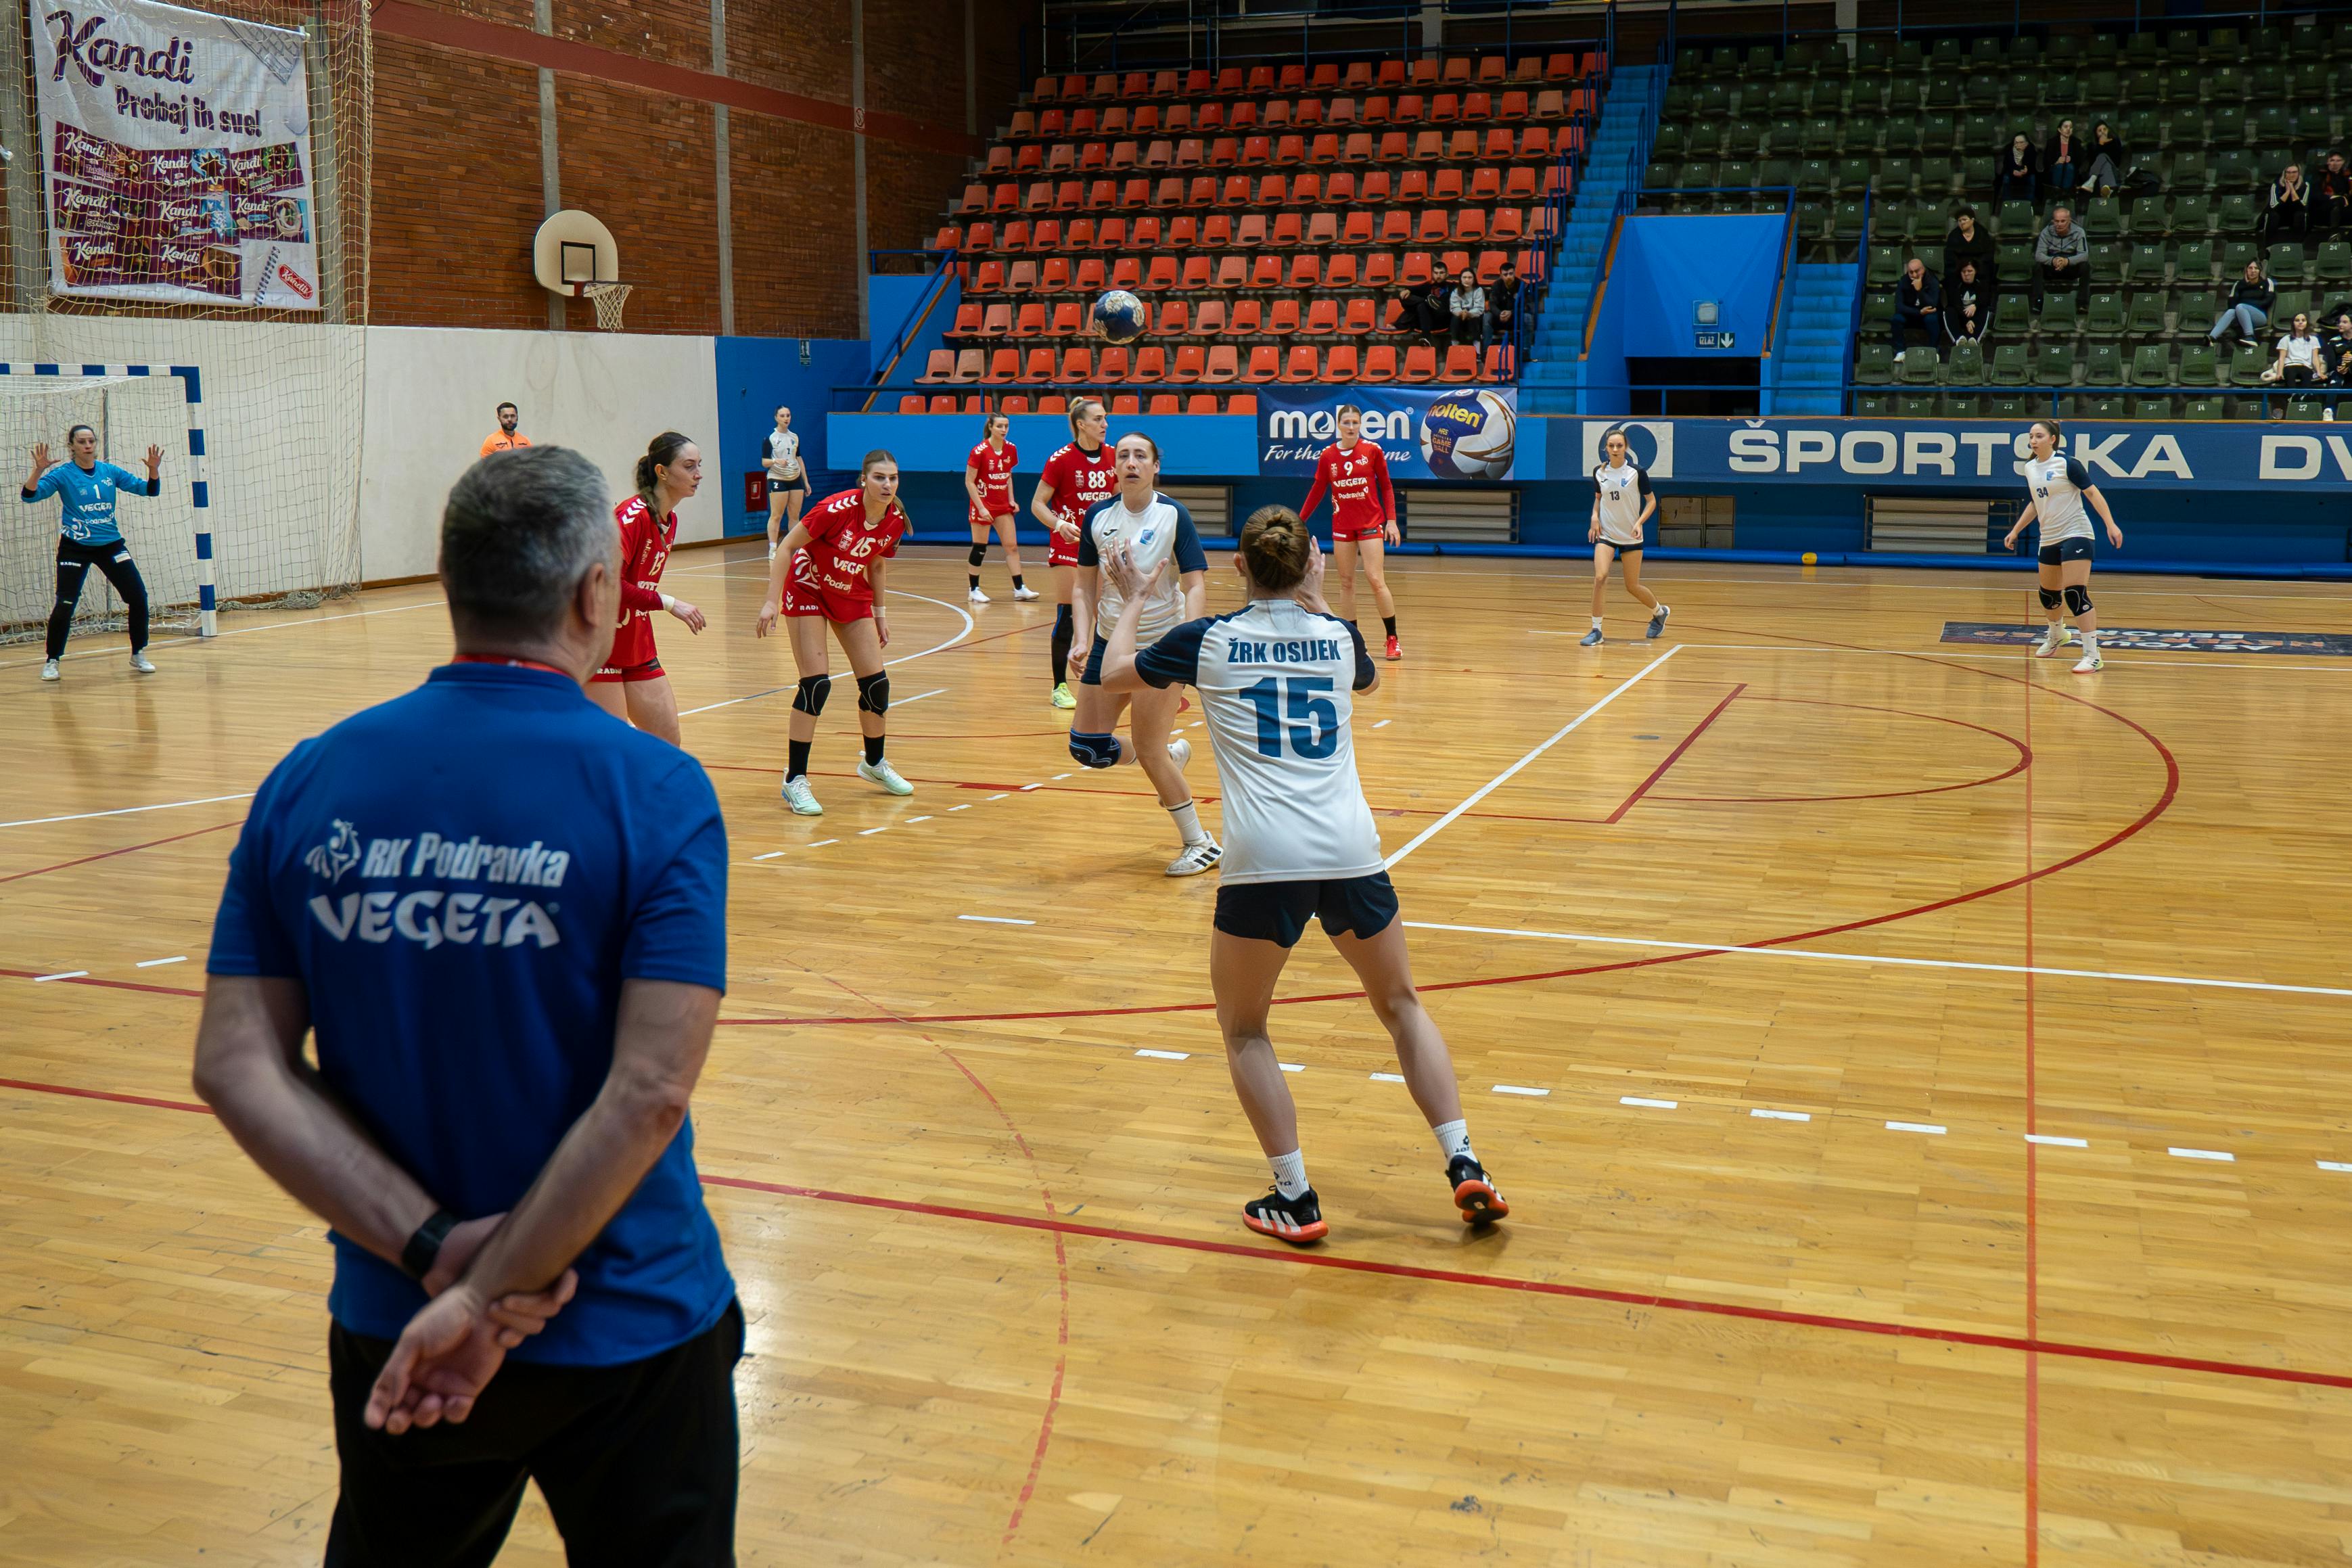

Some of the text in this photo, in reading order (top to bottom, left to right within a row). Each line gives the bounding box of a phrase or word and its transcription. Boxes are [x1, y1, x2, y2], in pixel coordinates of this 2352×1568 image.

[45, 10, 195, 88] Kandi
[115, 85, 262, 137] Probaj ih sve!
[66, 132, 106, 158] Kandi
[150, 156, 189, 175] Kandi
[231, 156, 261, 176] Kandi
[64, 188, 108, 208] Kandi
[235, 197, 269, 214] Kandi
[158, 202, 198, 221] Kandi
[73, 241, 115, 261] Kandi
[162, 244, 200, 264] Kandi
[1699, 336, 1715, 345] IZLAZ
[1270, 405, 1410, 440] molen
[1264, 444, 1294, 461] For
[997, 459, 1003, 471] 4
[1344, 461, 1353, 476] 9
[1088, 470, 1107, 488] 88
[1333, 477, 1368, 487] VEGETA
[93, 484, 101, 499] 1
[1609, 490, 1620, 501] 13
[2036, 486, 2049, 498] 34
[649, 551, 666, 576] 13
[1228, 638, 1341, 663] ŽRK OSIJEK
[2160, 637, 2325, 647] NEVER
[1239, 677, 1339, 759] 15
[361, 832, 570, 887] RK Podravka
[309, 891, 561, 949] VEGETA
